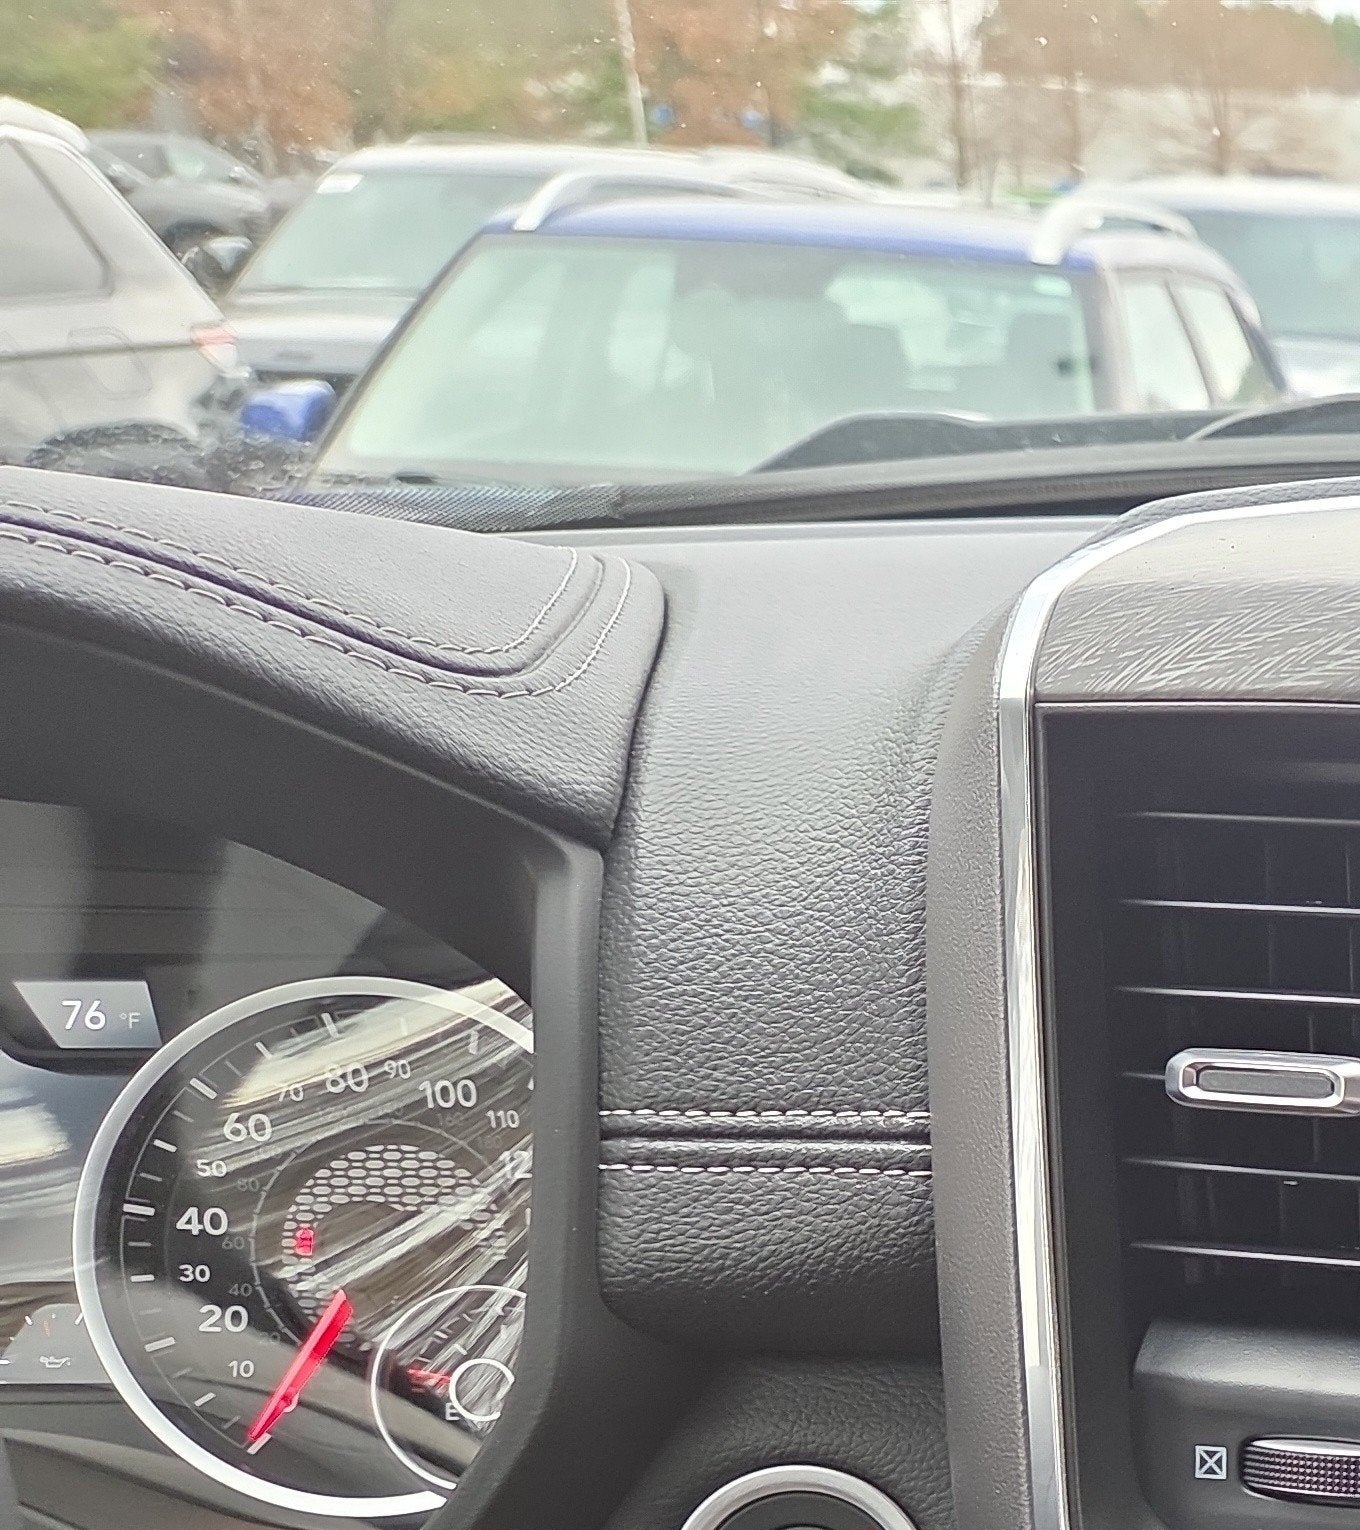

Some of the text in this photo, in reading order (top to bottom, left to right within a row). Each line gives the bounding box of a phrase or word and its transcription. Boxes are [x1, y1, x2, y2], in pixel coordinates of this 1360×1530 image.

[61, 1000, 106, 1031] 76
[326, 1063, 369, 1093] 80
[384, 1060, 411, 1079] 90
[419, 1079, 477, 1109] 100
[223, 1113, 272, 1142] 60
[486, 1109, 520, 1129] 110
[196, 1159, 227, 1178] 50
[176, 1207, 229, 1236] 40
[178, 1264, 211, 1283] 30
[198, 1304, 249, 1333] 20
[227, 1360, 254, 1378] 10
